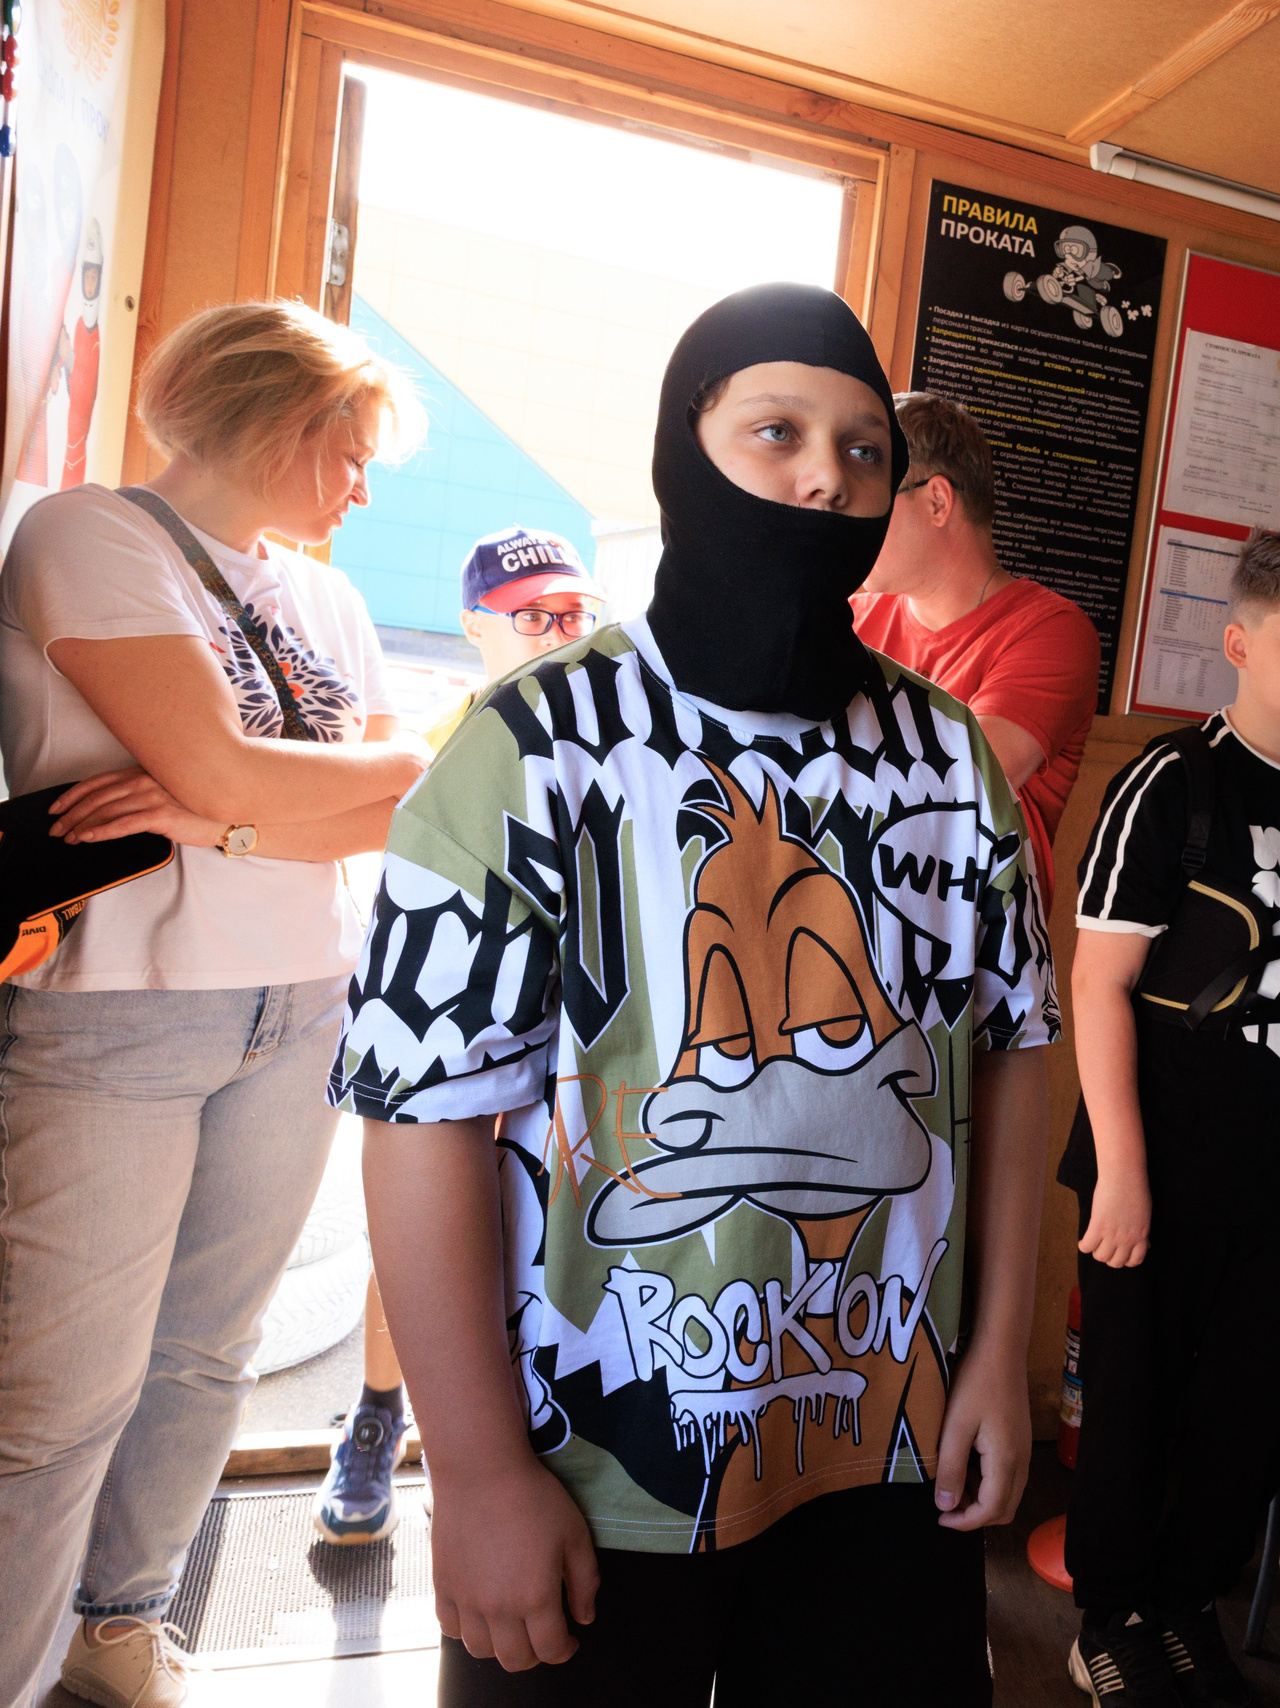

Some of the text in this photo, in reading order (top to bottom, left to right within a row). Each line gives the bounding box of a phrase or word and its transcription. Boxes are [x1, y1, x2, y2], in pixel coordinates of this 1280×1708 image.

[943, 195, 1038, 235] ПРАВИЛА
[940, 218, 1036, 258] ПРОКАТА
[932, 316, 968, 330] персонала
[933, 305, 963, 319] Посадка
[970, 314, 1000, 327] высадка
[1010, 322, 1028, 333] карта
[1030, 327, 1080, 345] осуществляется
[1081, 338, 1103, 350] только
[1109, 344, 1147, 359] разрешения
[931, 325, 976, 342] Запрещается
[976, 335, 1018, 351] прикасаться
[1023, 345, 1047, 357] любым
[930, 335, 975, 352] Запрещается
[992, 349, 1013, 360] время
[1017, 354, 1040, 366] заезда
[1043, 360, 1071, 372] вставать
[1087, 369, 1106, 380] карта
[1118, 376, 1144, 388] снимать
[926, 375, 972, 391] запрещается
[977, 386, 1033, 404] предпринимать
[927, 365, 943, 375] Если
[944, 369, 960, 379] карт
[971, 375, 992, 385] время
[994, 379, 1016, 390] заезда
[928, 355, 973, 372] Запрещается
[973, 365, 1028, 383] одновременное
[1028, 376, 1056, 389] нажатие
[1057, 382, 1085, 395] педалей
[1085, 388, 1098, 398] газа
[969, 405, 985, 414] руку
[985, 408, 1005, 418] вверх
[1011, 413, 1032, 424] ждать
[1032, 417, 1060, 429] помощи
[1033, 407, 1073, 422] Необходимо
[1074, 416, 1096, 426] убрать
[1045, 430, 1066, 440] только
[1016, 443, 1040, 454] борьба
[1052, 450, 1097, 465] столкновения
